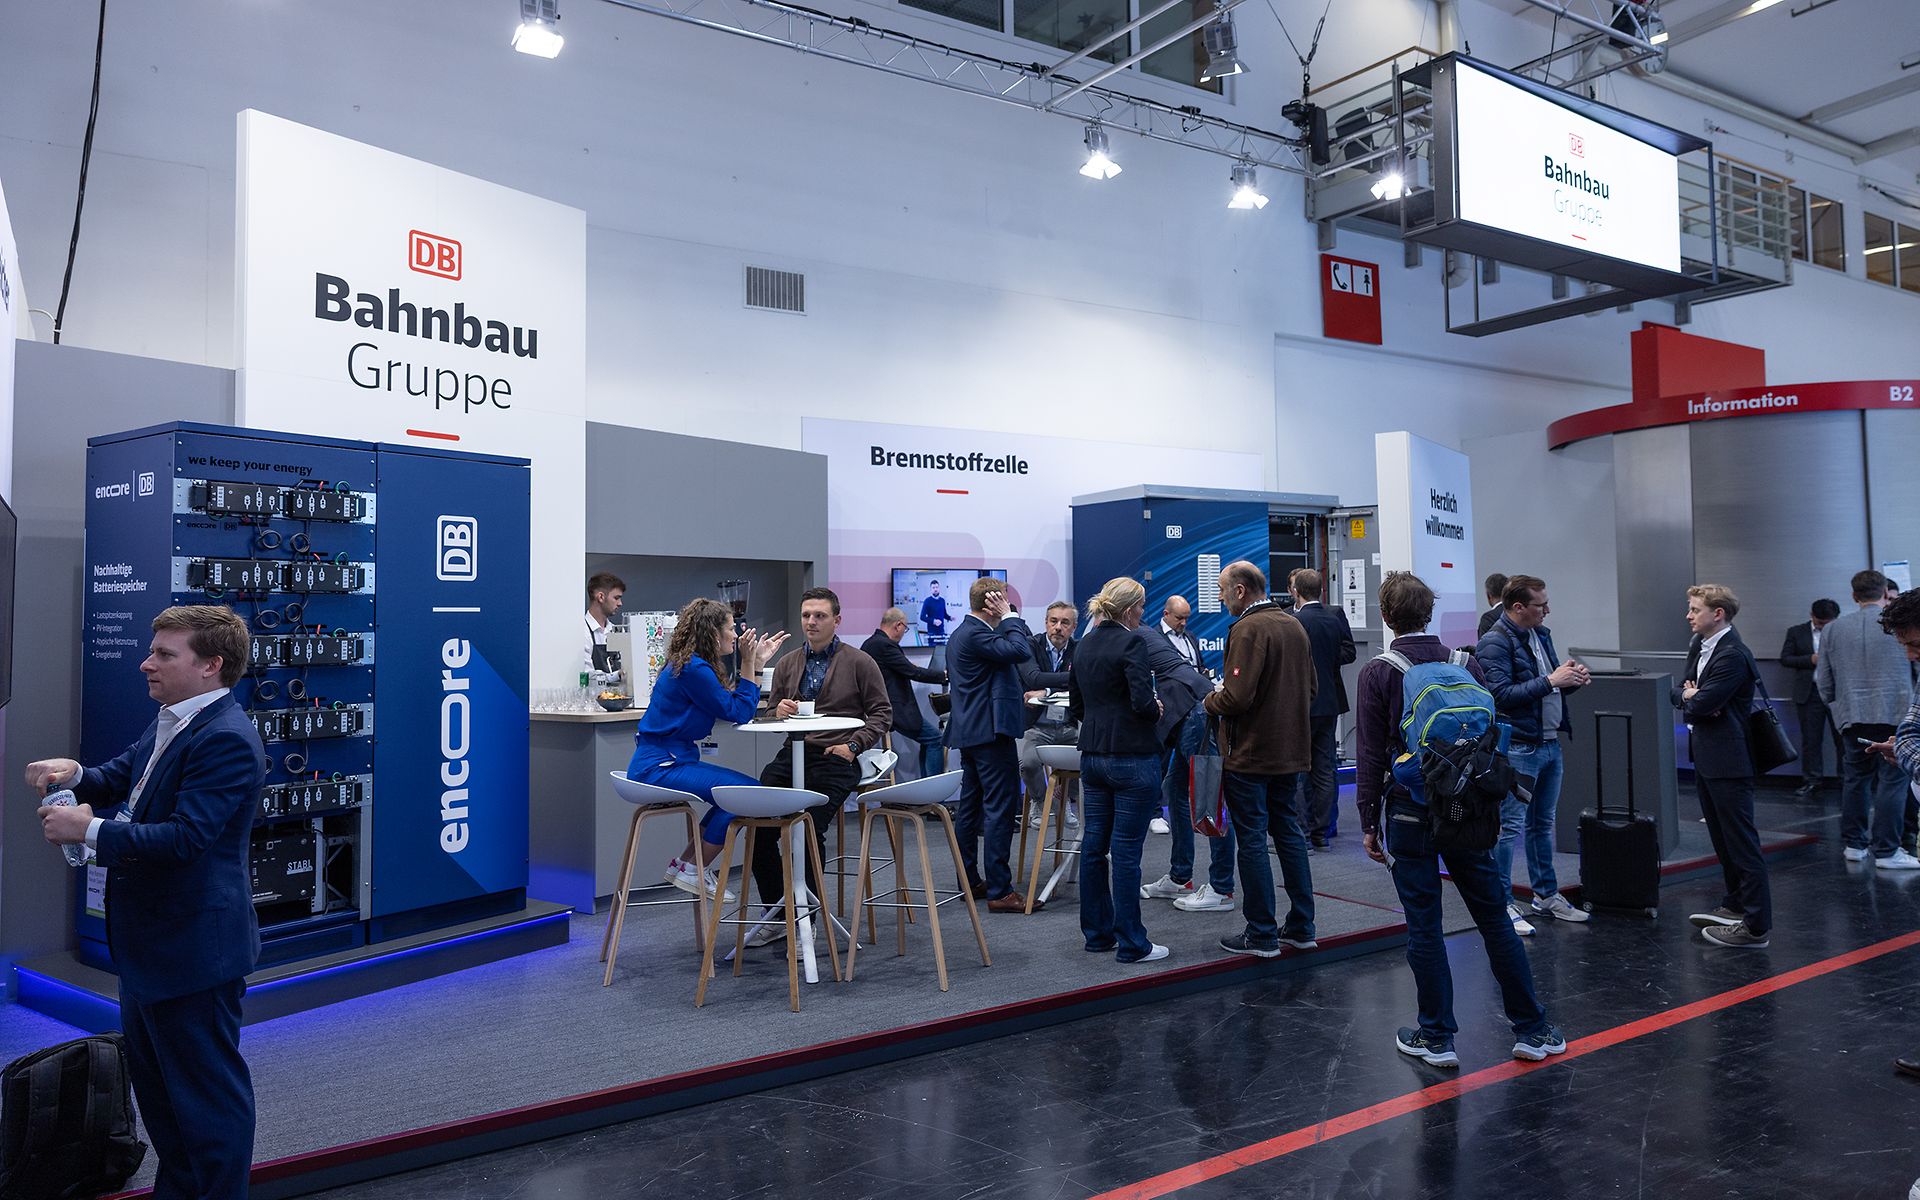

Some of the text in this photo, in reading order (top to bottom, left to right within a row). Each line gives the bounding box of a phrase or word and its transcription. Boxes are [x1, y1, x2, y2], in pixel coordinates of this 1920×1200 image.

[1570, 135, 1583, 156] DB
[1544, 155, 1609, 200] Bahnbau
[413, 235, 458, 276] DB
[315, 272, 538, 359] Bahnbau
[347, 342, 512, 414] Gruppe
[1687, 393, 1798, 415] Information
[1890, 386, 1914, 401] B2
[188, 456, 313, 476] we keep your energy
[870, 445, 1028, 474] Brennstoffzelle
[95, 474, 153, 499] encore DB
[1430, 488, 1458, 513] Herzlich
[1167, 527, 1181, 537] DB
[1425, 514, 1464, 541] willkommen
[93, 562, 133, 577] Nachhaltige
[93, 579, 147, 594] Batteriespeicher
[1200, 637, 1224, 651] Rail
[440, 519, 475, 854] encore DB
